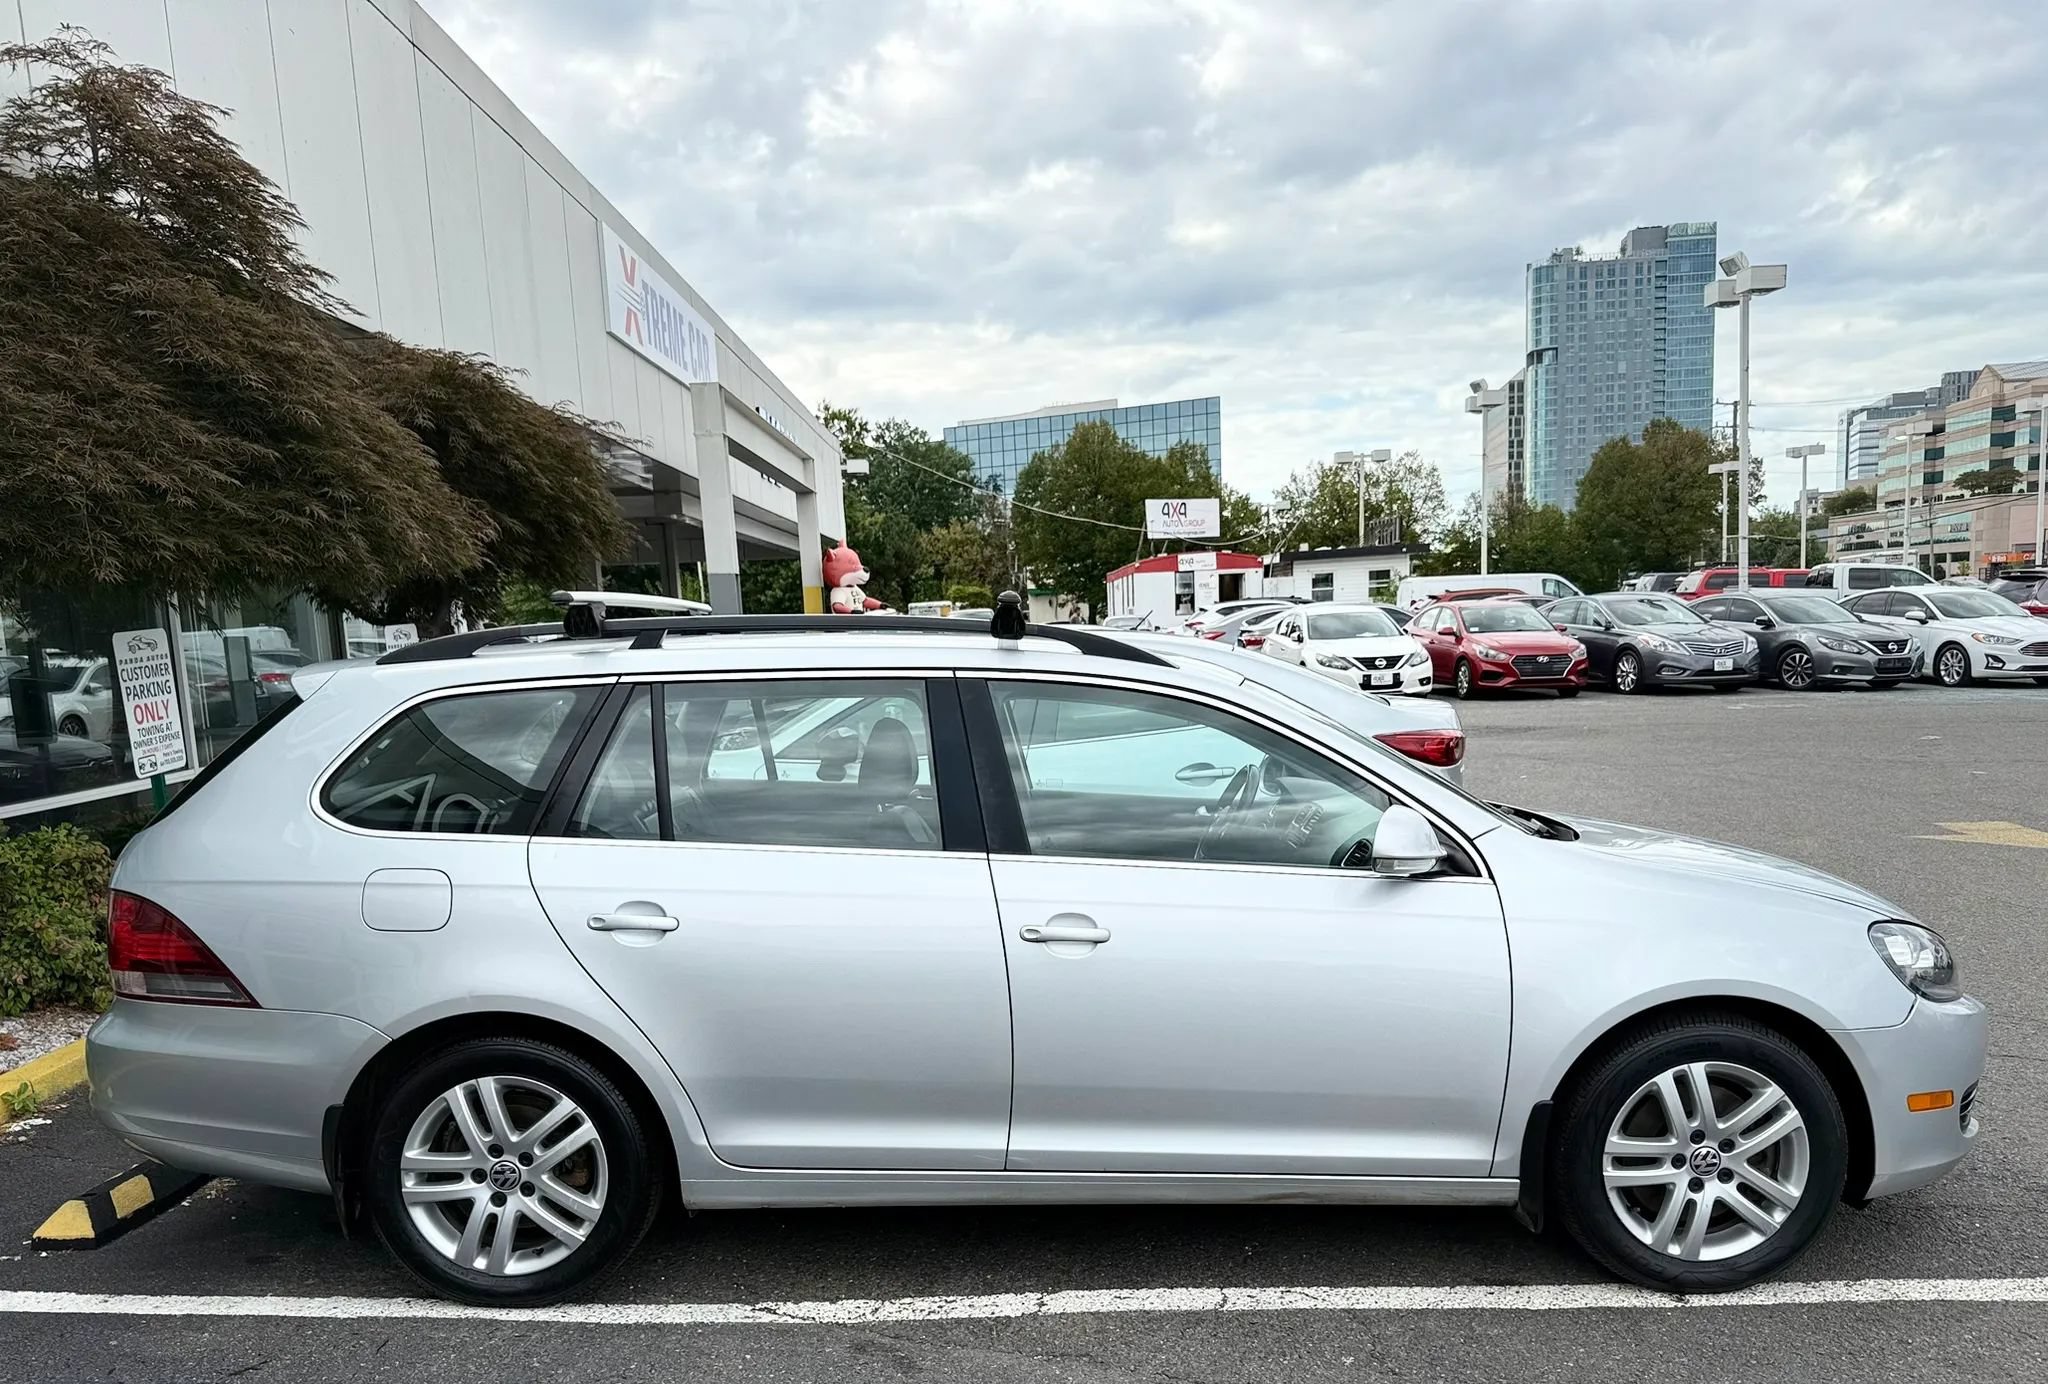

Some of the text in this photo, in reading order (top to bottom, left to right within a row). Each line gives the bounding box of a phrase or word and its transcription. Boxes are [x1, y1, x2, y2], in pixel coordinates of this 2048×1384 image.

[688, 320, 711, 382] CAR
[1163, 519, 1206, 528] AUTO GROUP
[119, 653, 169, 666] PANDA AUTOS
[120, 662, 171, 683] CUSTOMER
[125, 679, 172, 702] PARKING
[133, 698, 170, 725] ONLY
[137, 721, 173, 738] TOWING AT
[133, 731, 181, 750] OWNER'S EXPENSE
